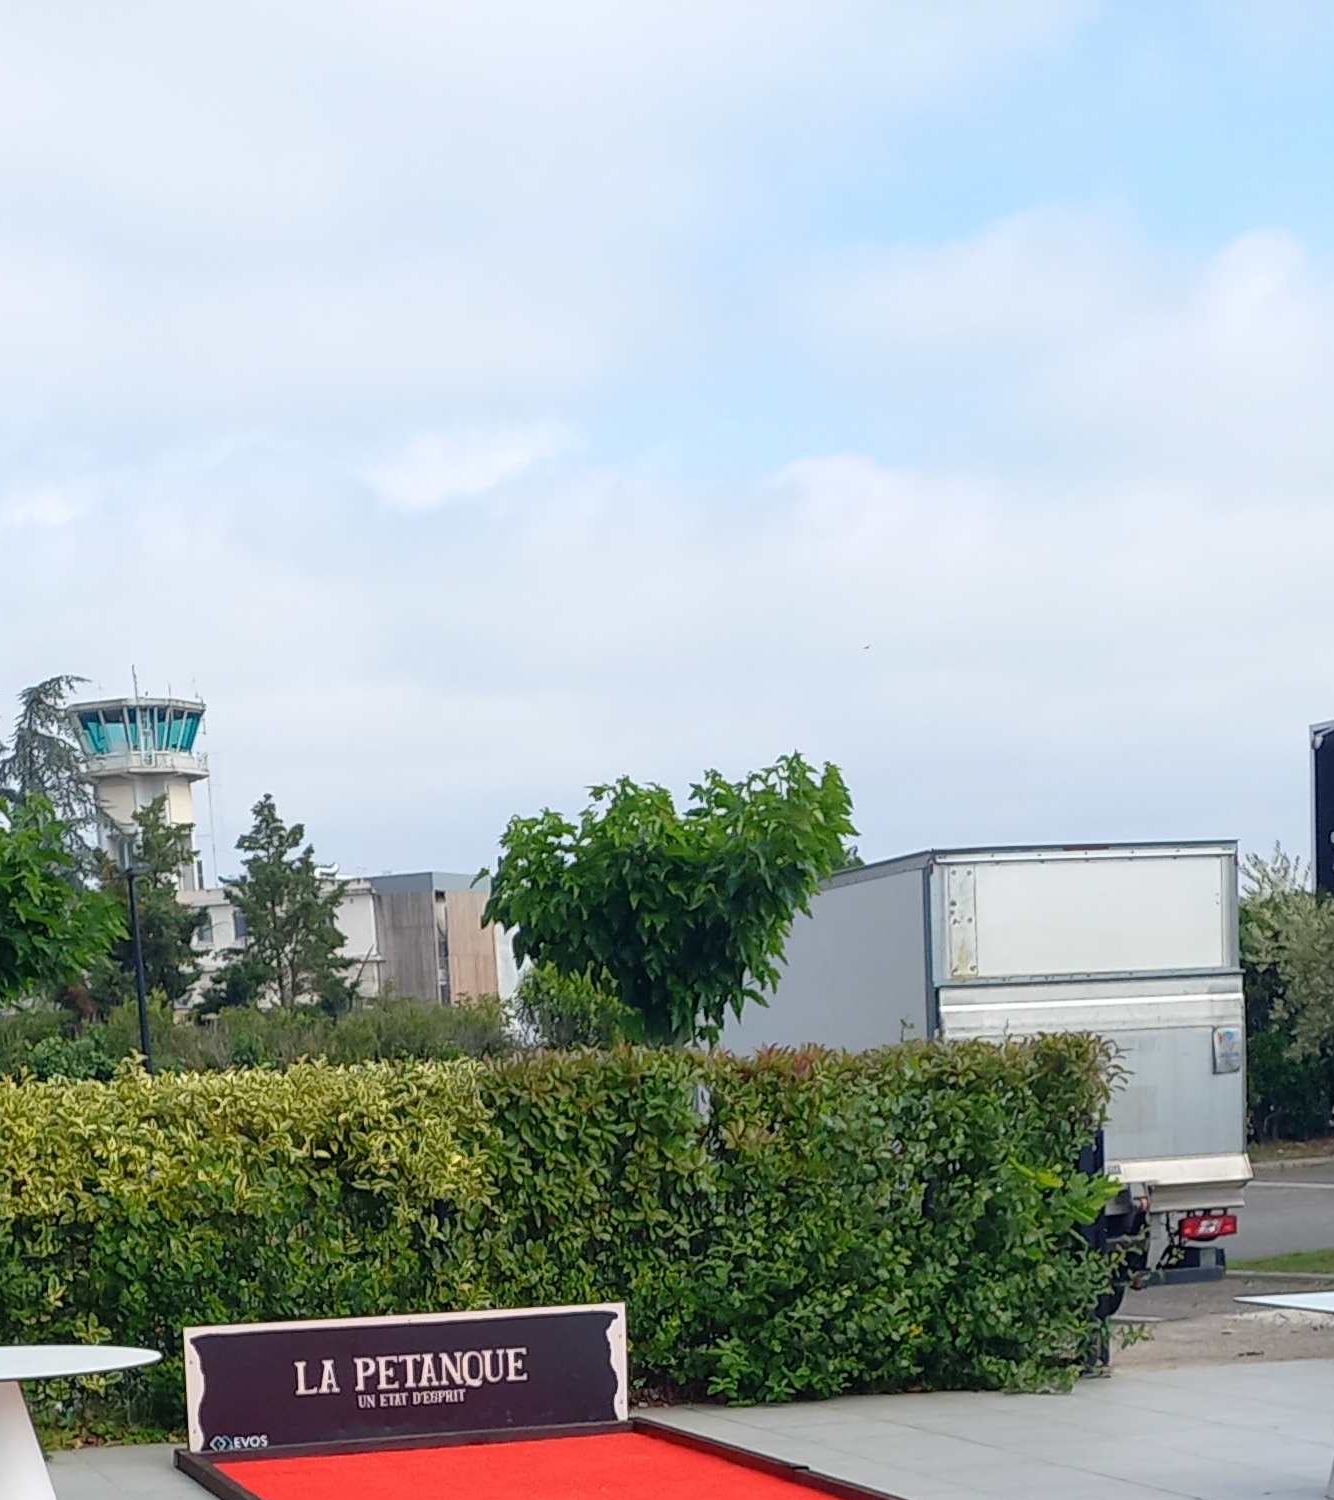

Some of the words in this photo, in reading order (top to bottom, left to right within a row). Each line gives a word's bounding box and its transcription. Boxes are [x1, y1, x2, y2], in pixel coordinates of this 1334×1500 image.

[294, 1360, 340, 1395] LA
[354, 1347, 528, 1391] PETANQUE
[358, 1394, 376, 1408] UN
[380, 1392, 408, 1407] ETAT
[412, 1388, 466, 1405] D'ESPRIT
[233, 1435, 267, 1449] EVOS
